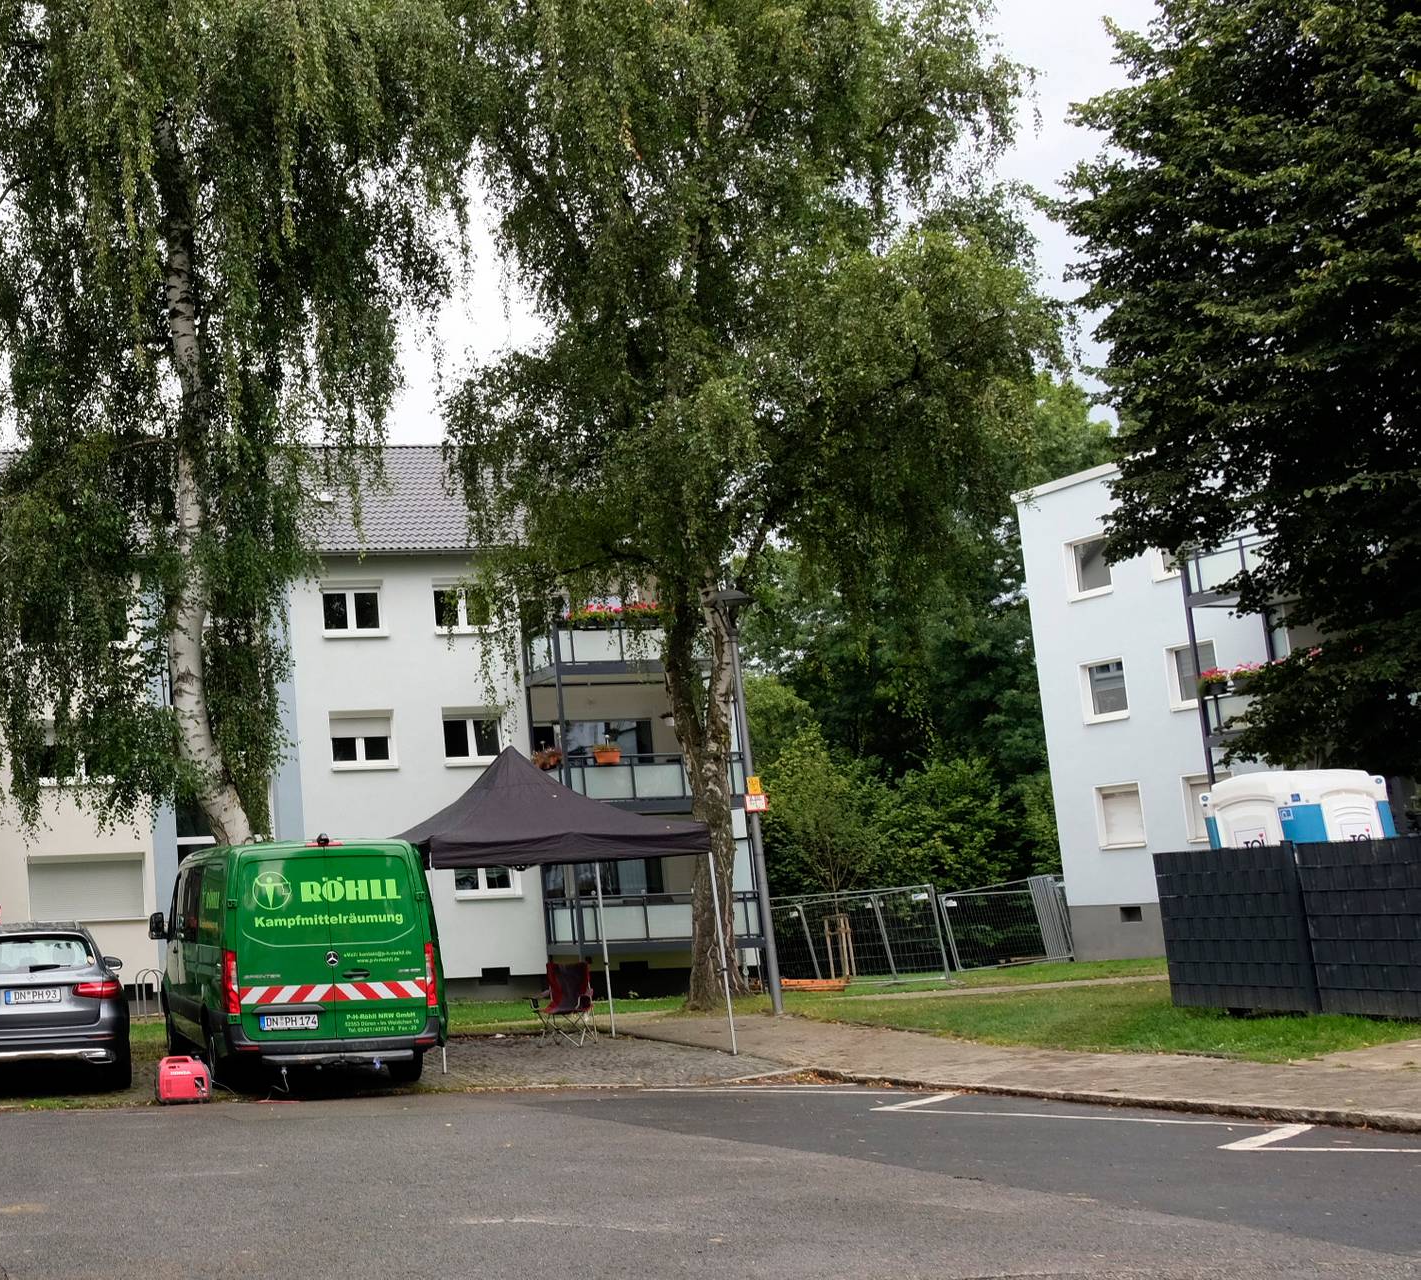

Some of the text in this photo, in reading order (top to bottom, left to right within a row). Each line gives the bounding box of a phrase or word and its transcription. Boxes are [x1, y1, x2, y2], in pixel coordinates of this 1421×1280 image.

[300, 877, 402, 903] RÖHLL
[254, 913, 404, 928] Kampfmittelräumung
[14, 990, 57, 1001] DN PH 93
[266, 1016, 317, 1027] DN PH 174
